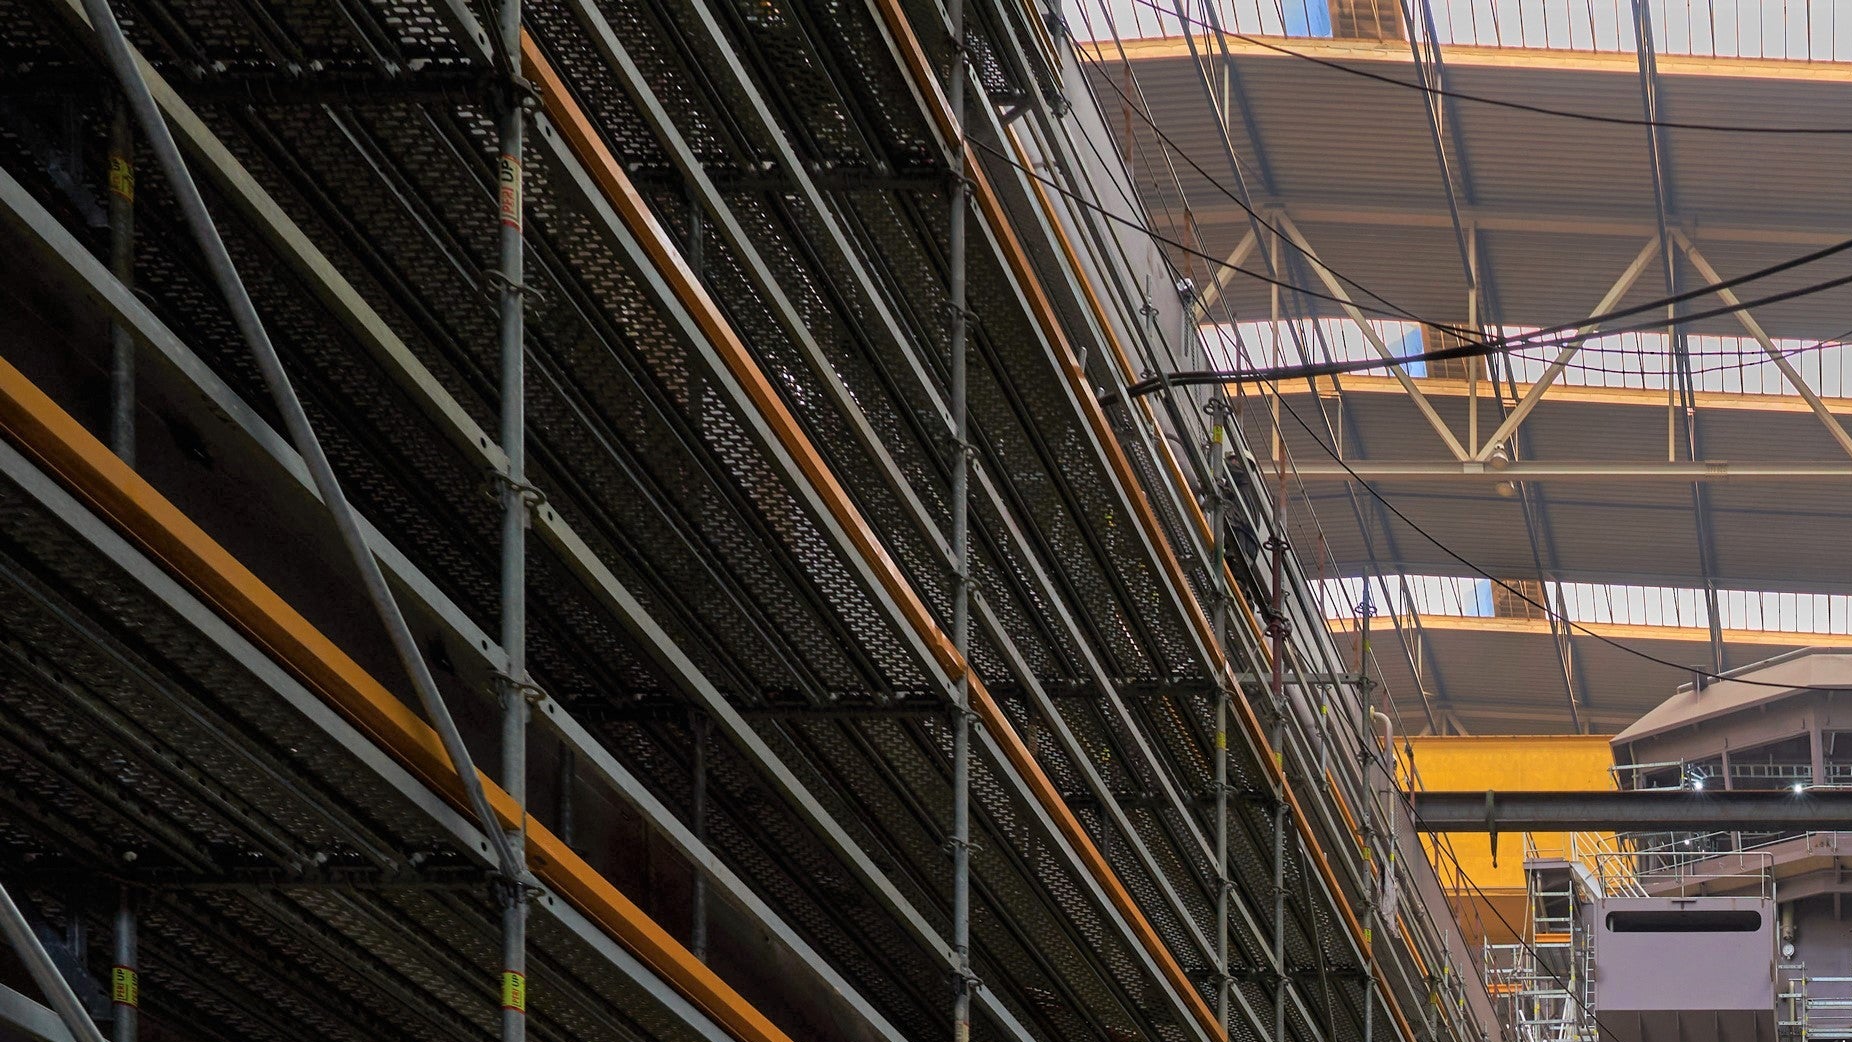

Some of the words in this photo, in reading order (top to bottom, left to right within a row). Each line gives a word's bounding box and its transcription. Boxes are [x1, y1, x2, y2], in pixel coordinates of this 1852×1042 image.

[501, 159, 514, 182] UP
[501, 186, 515, 215] PERI
[117, 968, 125, 981] UP
[511, 974, 520, 987] UP
[511, 988, 520, 1004] PERI
